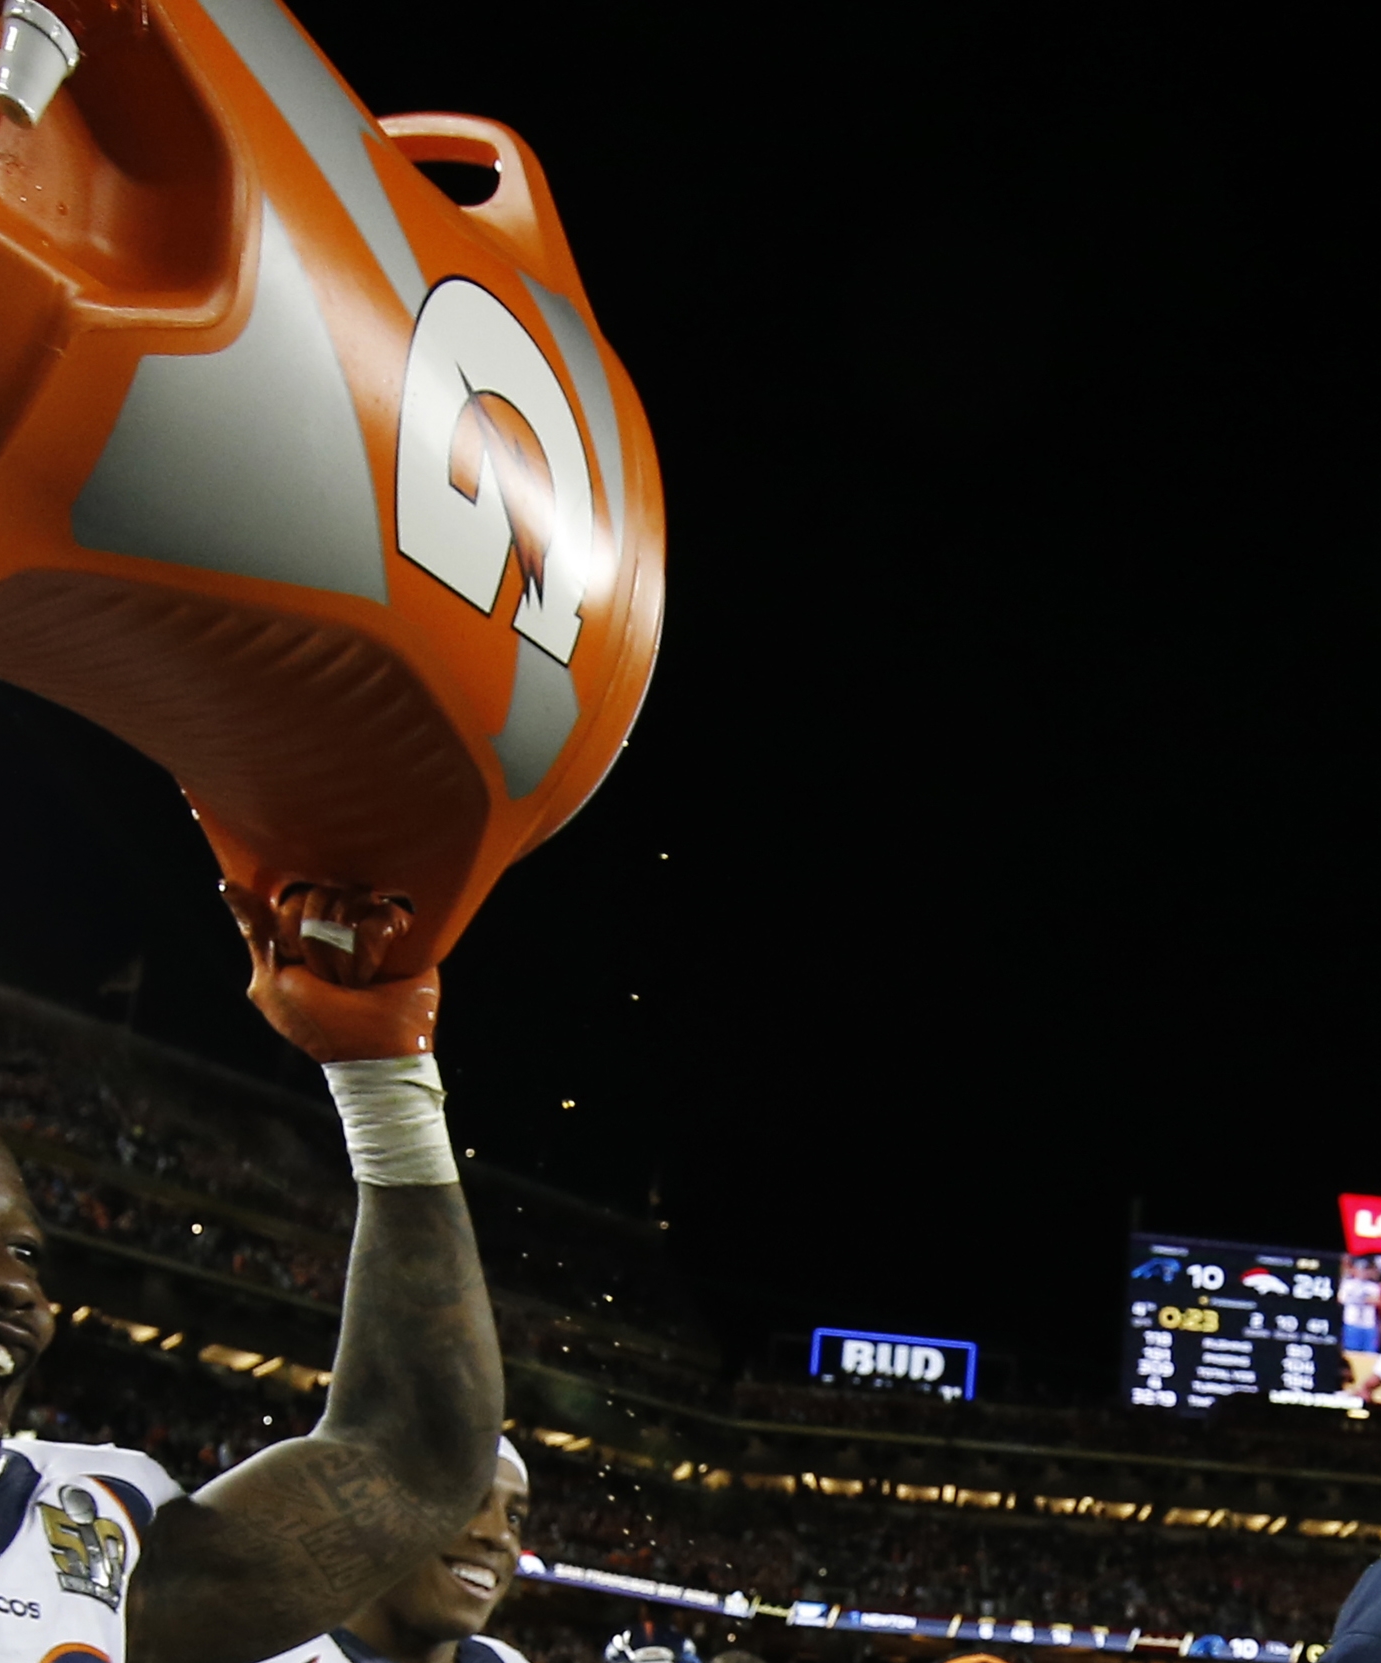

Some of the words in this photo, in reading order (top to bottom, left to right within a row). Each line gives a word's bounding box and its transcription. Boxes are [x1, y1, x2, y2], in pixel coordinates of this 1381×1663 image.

[1186, 1263, 1225, 1291] 10
[1292, 1273, 1334, 1301] 24
[841, 1339, 946, 1382] BUD
[1228, 1637, 1260, 1661] 10
